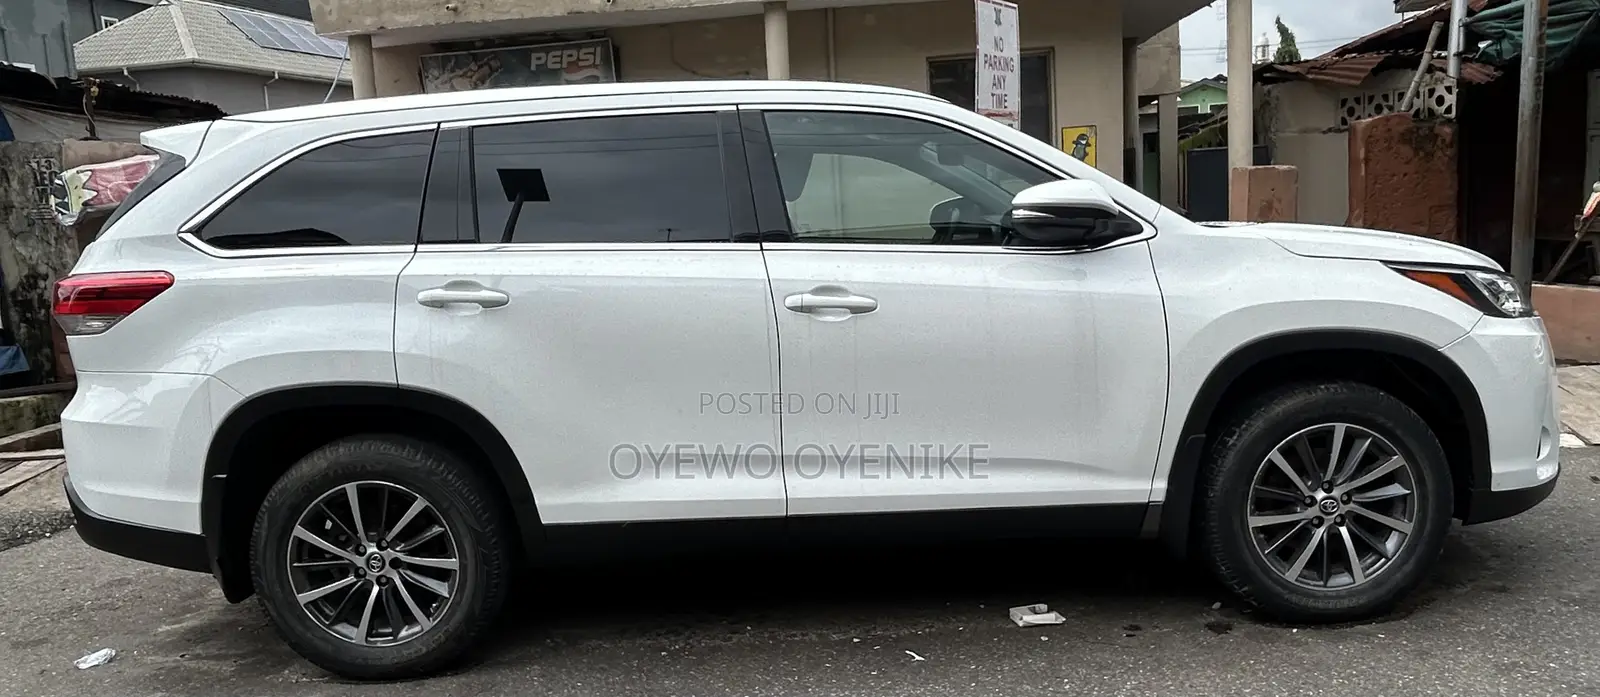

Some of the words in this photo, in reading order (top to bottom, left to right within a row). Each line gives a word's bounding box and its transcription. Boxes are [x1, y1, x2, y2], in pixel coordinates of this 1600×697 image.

[993, 35, 1004, 53] NO
[530, 46, 603, 71] PEPSI
[983, 53, 1015, 73] PARKING
[991, 73, 1007, 91] ANY
[990, 92, 1008, 109] TIME
